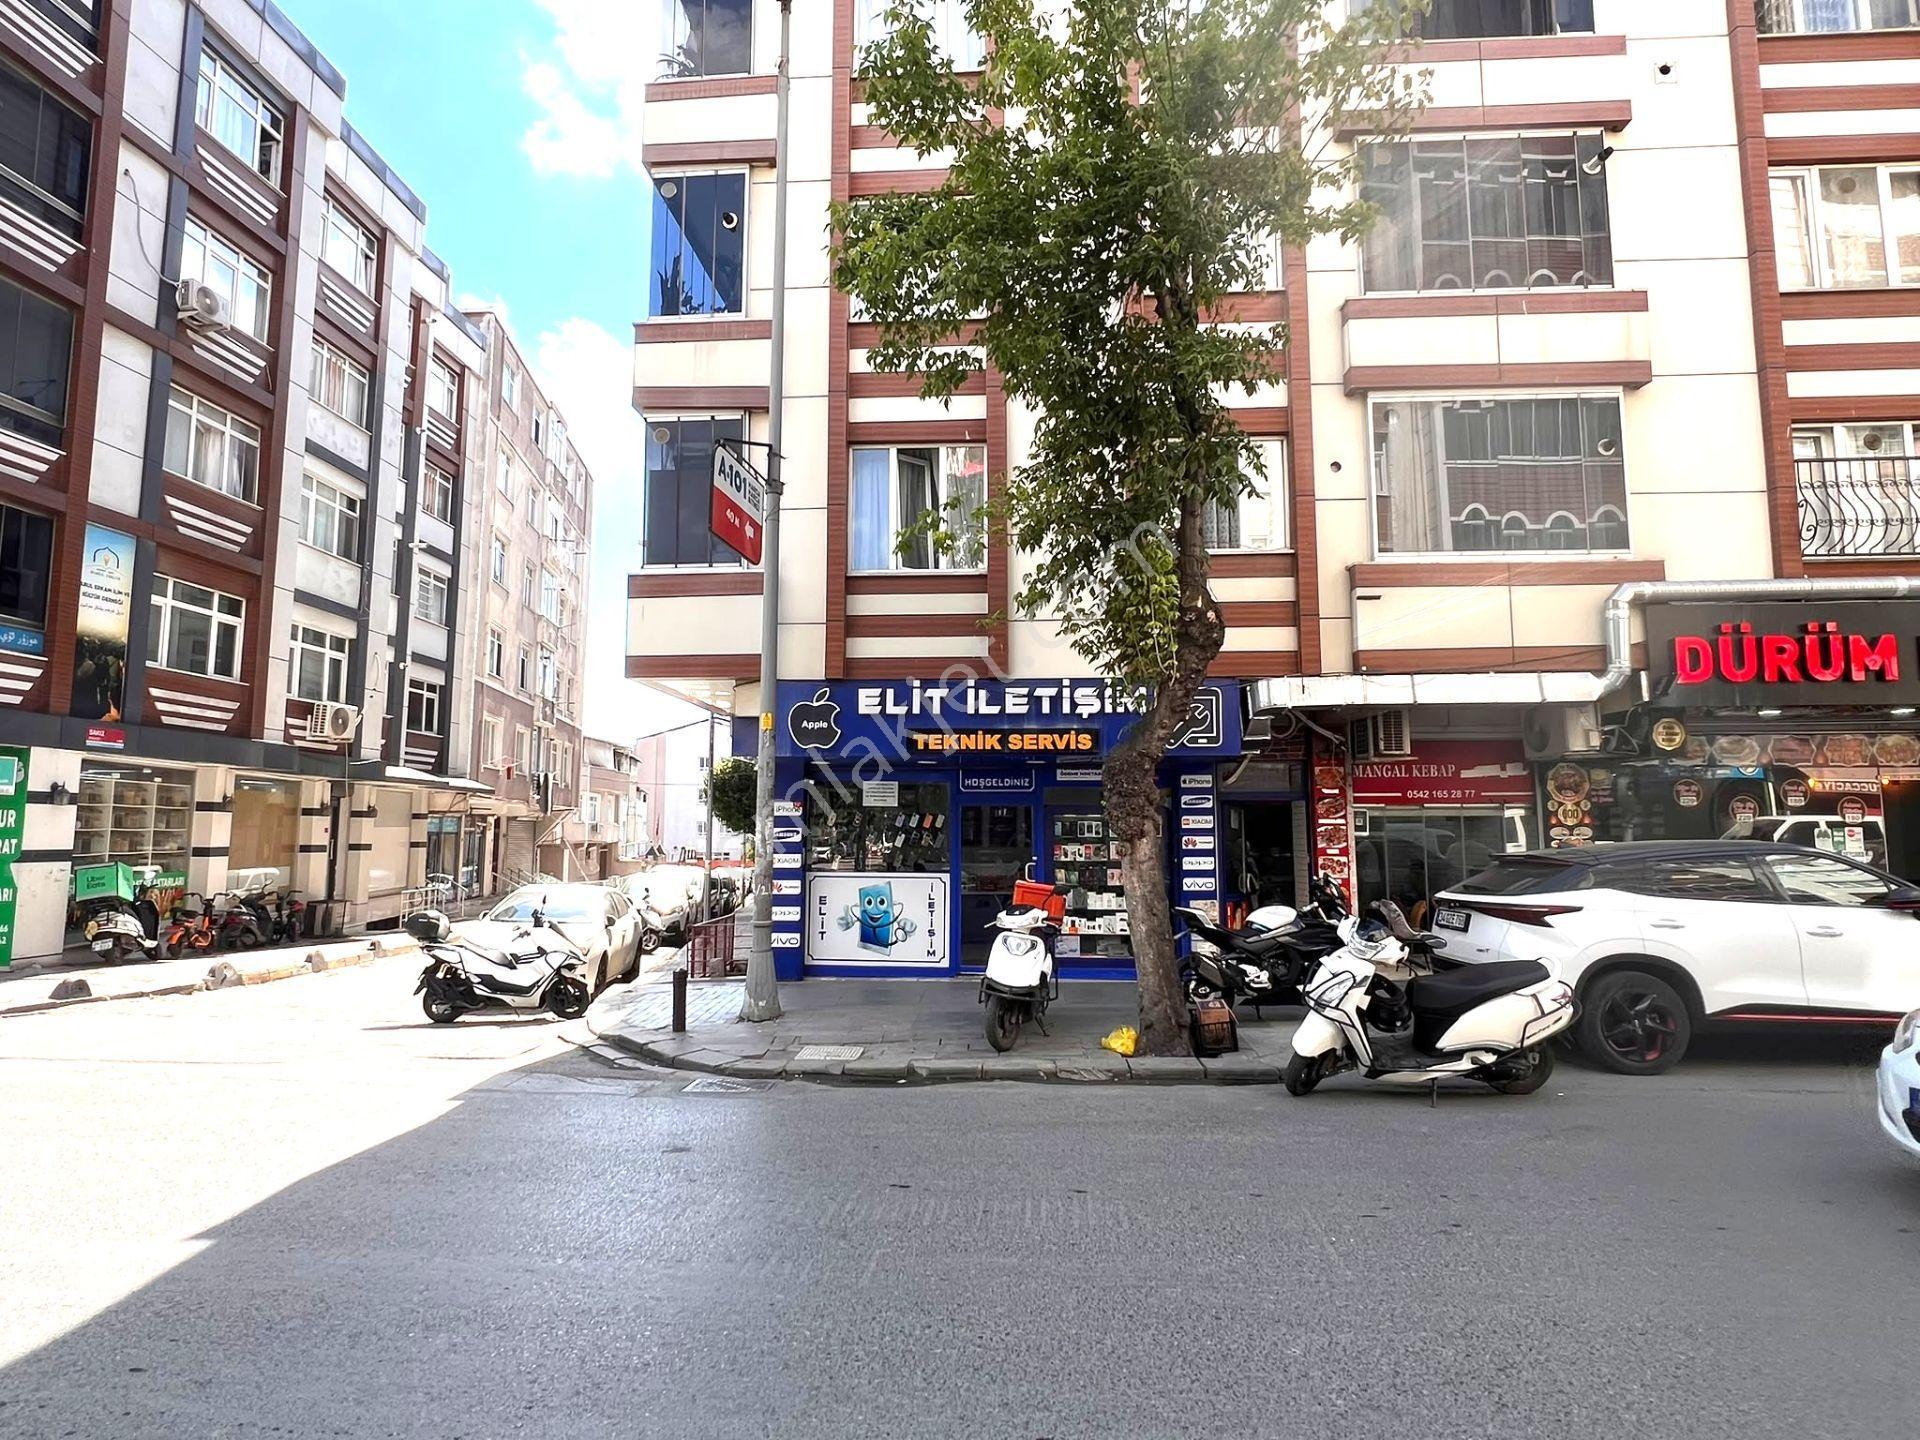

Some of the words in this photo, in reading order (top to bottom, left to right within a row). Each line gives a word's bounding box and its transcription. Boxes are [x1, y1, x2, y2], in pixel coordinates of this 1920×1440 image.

[1674, 620, 1900, 685] DÜRÜM
[858, 680, 950, 715] ELİT
[801, 719, 829, 731] Apple
[912, 731, 1001, 750] TEKNİK
[1007, 730, 1093, 751] SERVİS
[1353, 764, 1409, 778] MANGAL
[1411, 763, 1456, 778] KEBAP
[964, 776, 1031, 789] HOŞGELDİNİZ
[1187, 777, 1211, 785] iPhone
[1406, 789, 1430, 799] 0542
[1432, 789, 1449, 799] 165
[1450, 789, 1463, 799] 28
[1464, 789, 1476, 798] 77
